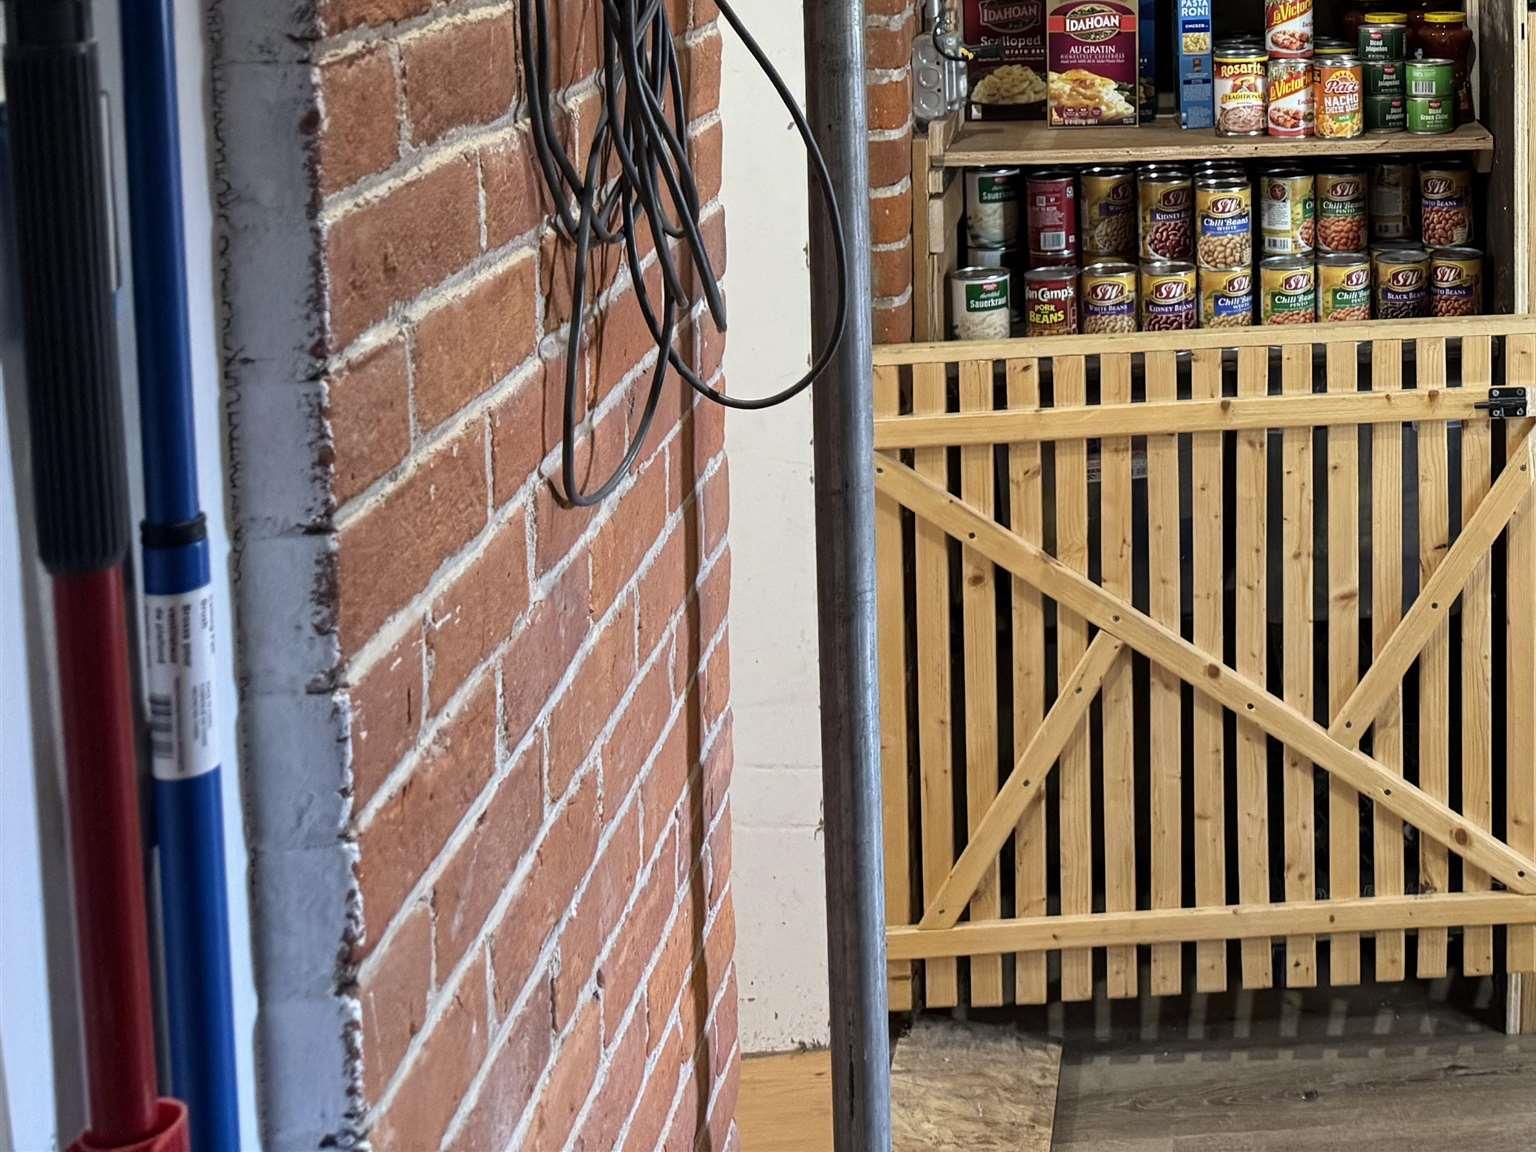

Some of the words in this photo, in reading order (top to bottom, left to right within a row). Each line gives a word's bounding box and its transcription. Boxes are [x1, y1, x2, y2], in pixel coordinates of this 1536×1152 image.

[983, 4, 1038, 22] IDAHOAN
[1181, 7, 1209, 17] RONI
[1065, 14, 1120, 32] IDAHOAN
[1069, 45, 1081, 54] AU
[1082, 45, 1116, 54] GRATIN
[1324, 93, 1359, 107] NACHO
[1436, 199, 1457, 207] BEANS
[1155, 212, 1180, 221] KIDNEY
[1203, 217, 1225, 227] Chili
[1225, 217, 1249, 226] Beans
[1038, 286, 1074, 302] Camp's
[1336, 291, 1356, 300] Chili
[1387, 292, 1408, 300] BLACK
[1445, 288, 1467, 296] BEANS
[1218, 297, 1239, 307] Chili
[1274, 295, 1297, 305] Chili
[1034, 304, 1056, 312] PORK
[1108, 304, 1128, 312] BEANS
[1149, 304, 1174, 313] KIDNEY
[1174, 302, 1193, 312] BEANS
[1028, 310, 1065, 324] BEANS
